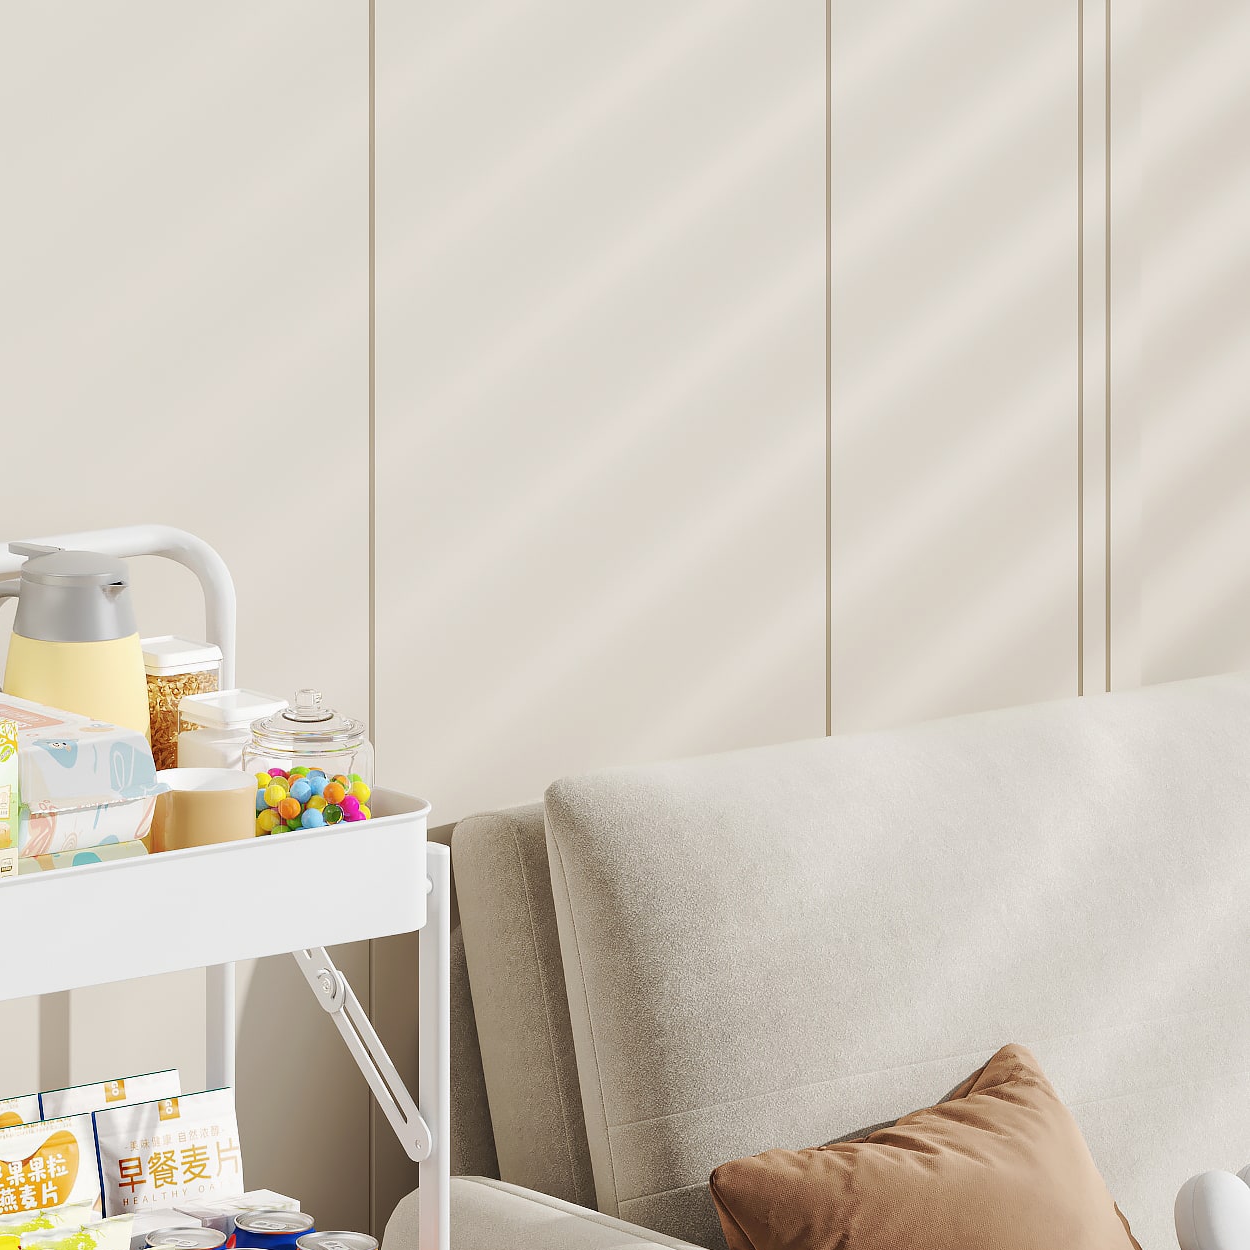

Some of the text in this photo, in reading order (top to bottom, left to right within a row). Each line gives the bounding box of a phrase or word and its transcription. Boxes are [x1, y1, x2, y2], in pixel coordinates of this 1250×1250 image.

[118, 1137, 239, 1193] 早餐麦片
[122, 1189, 188, 1206] HEALTHY
